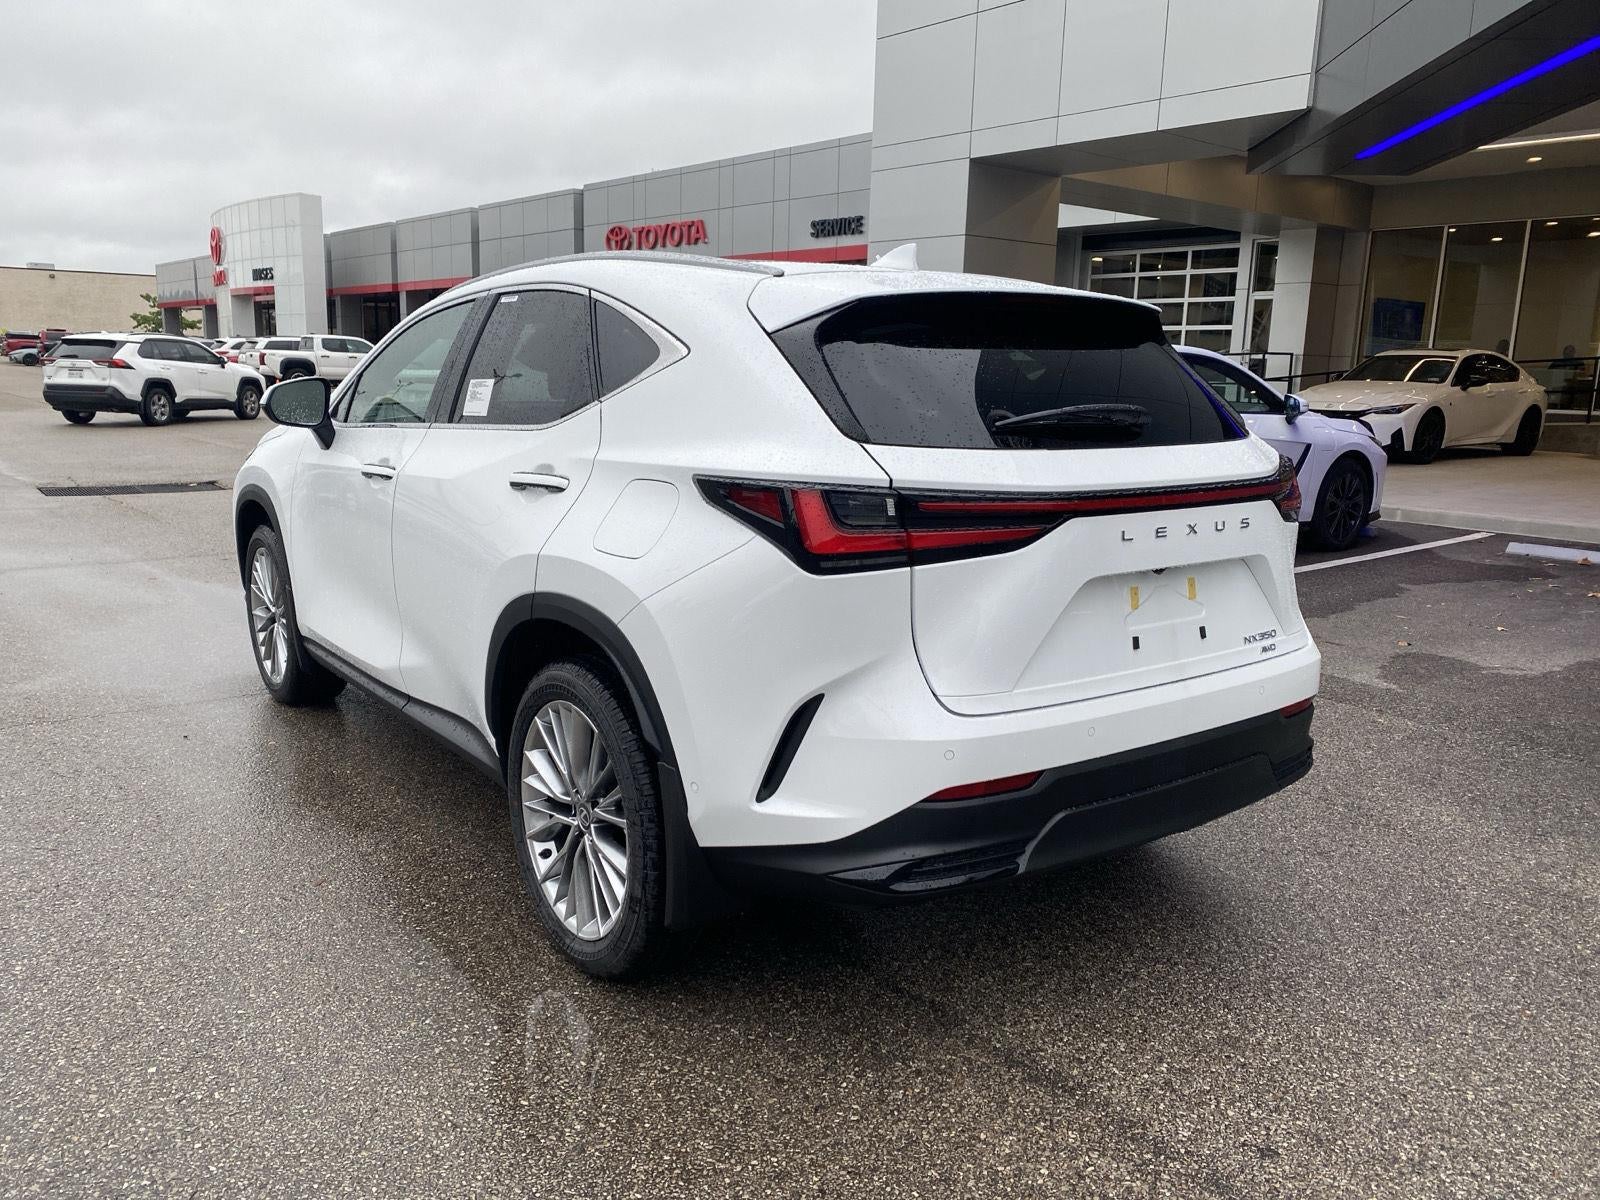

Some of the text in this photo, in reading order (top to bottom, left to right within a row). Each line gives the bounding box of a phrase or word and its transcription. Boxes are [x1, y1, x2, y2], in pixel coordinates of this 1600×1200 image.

[632, 219, 707, 250] TOYOTA
[810, 215, 864, 239] SERVICE
[1121, 517, 1251, 541] LEXUS
[1243, 629, 1277, 645] NX350
